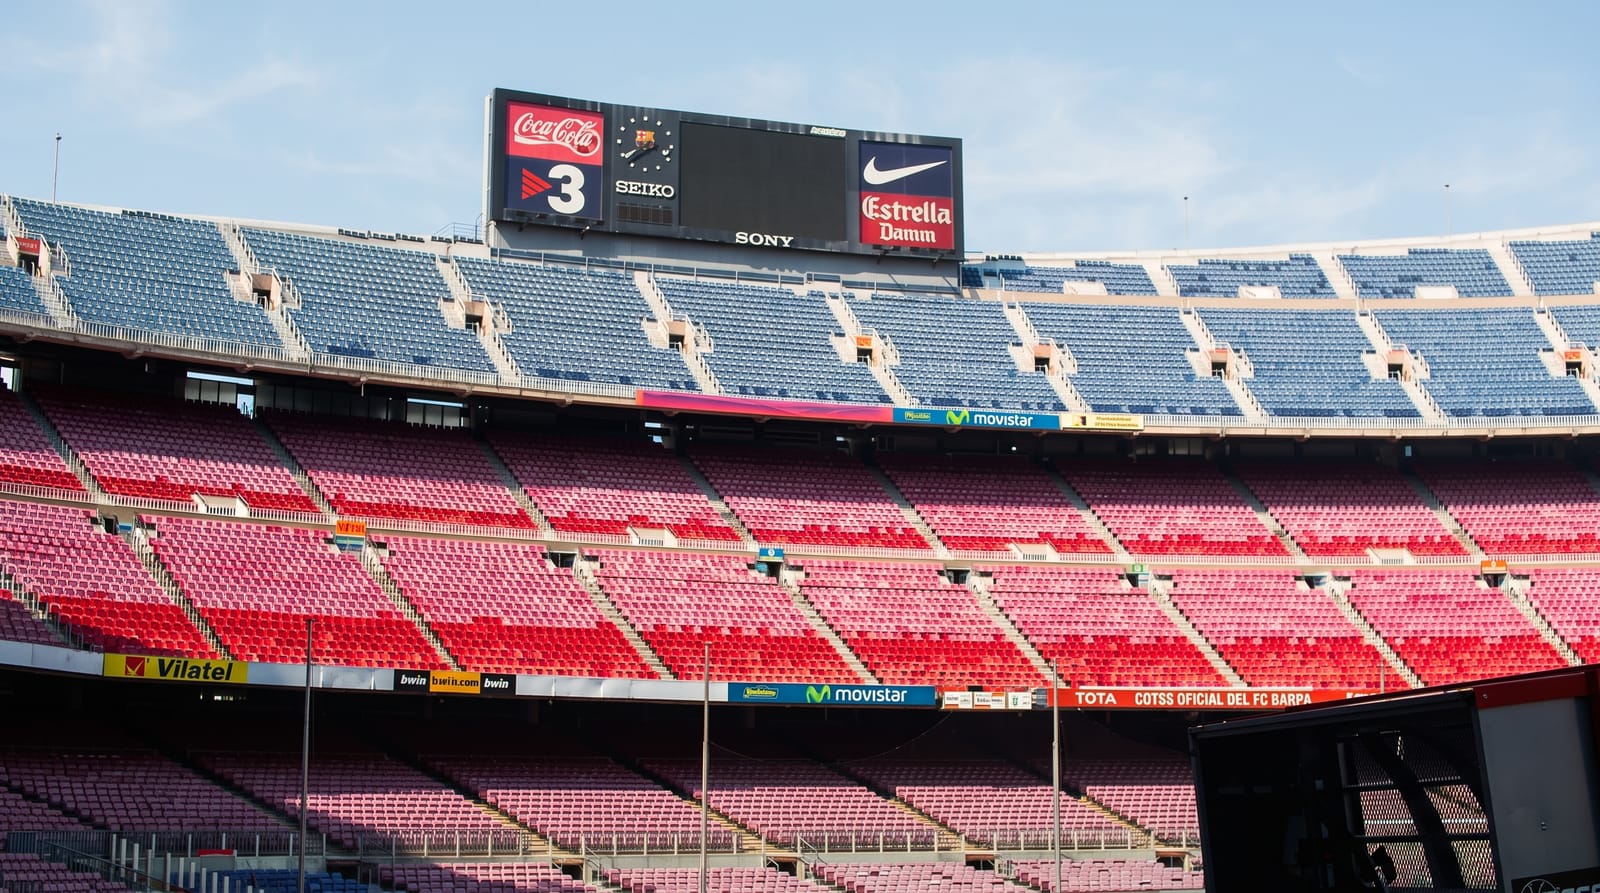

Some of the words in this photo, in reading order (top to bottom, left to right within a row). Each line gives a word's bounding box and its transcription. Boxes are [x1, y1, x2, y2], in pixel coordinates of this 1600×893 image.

[547, 164, 585, 214] 3
[615, 180, 674, 198] SEIKO
[862, 195, 952, 225] Estrella
[735, 231, 794, 247] SONY
[879, 222, 936, 243] Damm
[974, 414, 1033, 427] movistar
[158, 658, 233, 680] Vilatel
[400, 674, 427, 686] bwin
[484, 678, 509, 689] bwin
[835, 688, 907, 702] movistar
[1075, 692, 1117, 705] TOTA
[1135, 692, 1174, 705] COTSS
[1177, 692, 1223, 706] OFICIAL
[1227, 693, 1250, 706] DEL
[1253, 693, 1268, 706] FC
